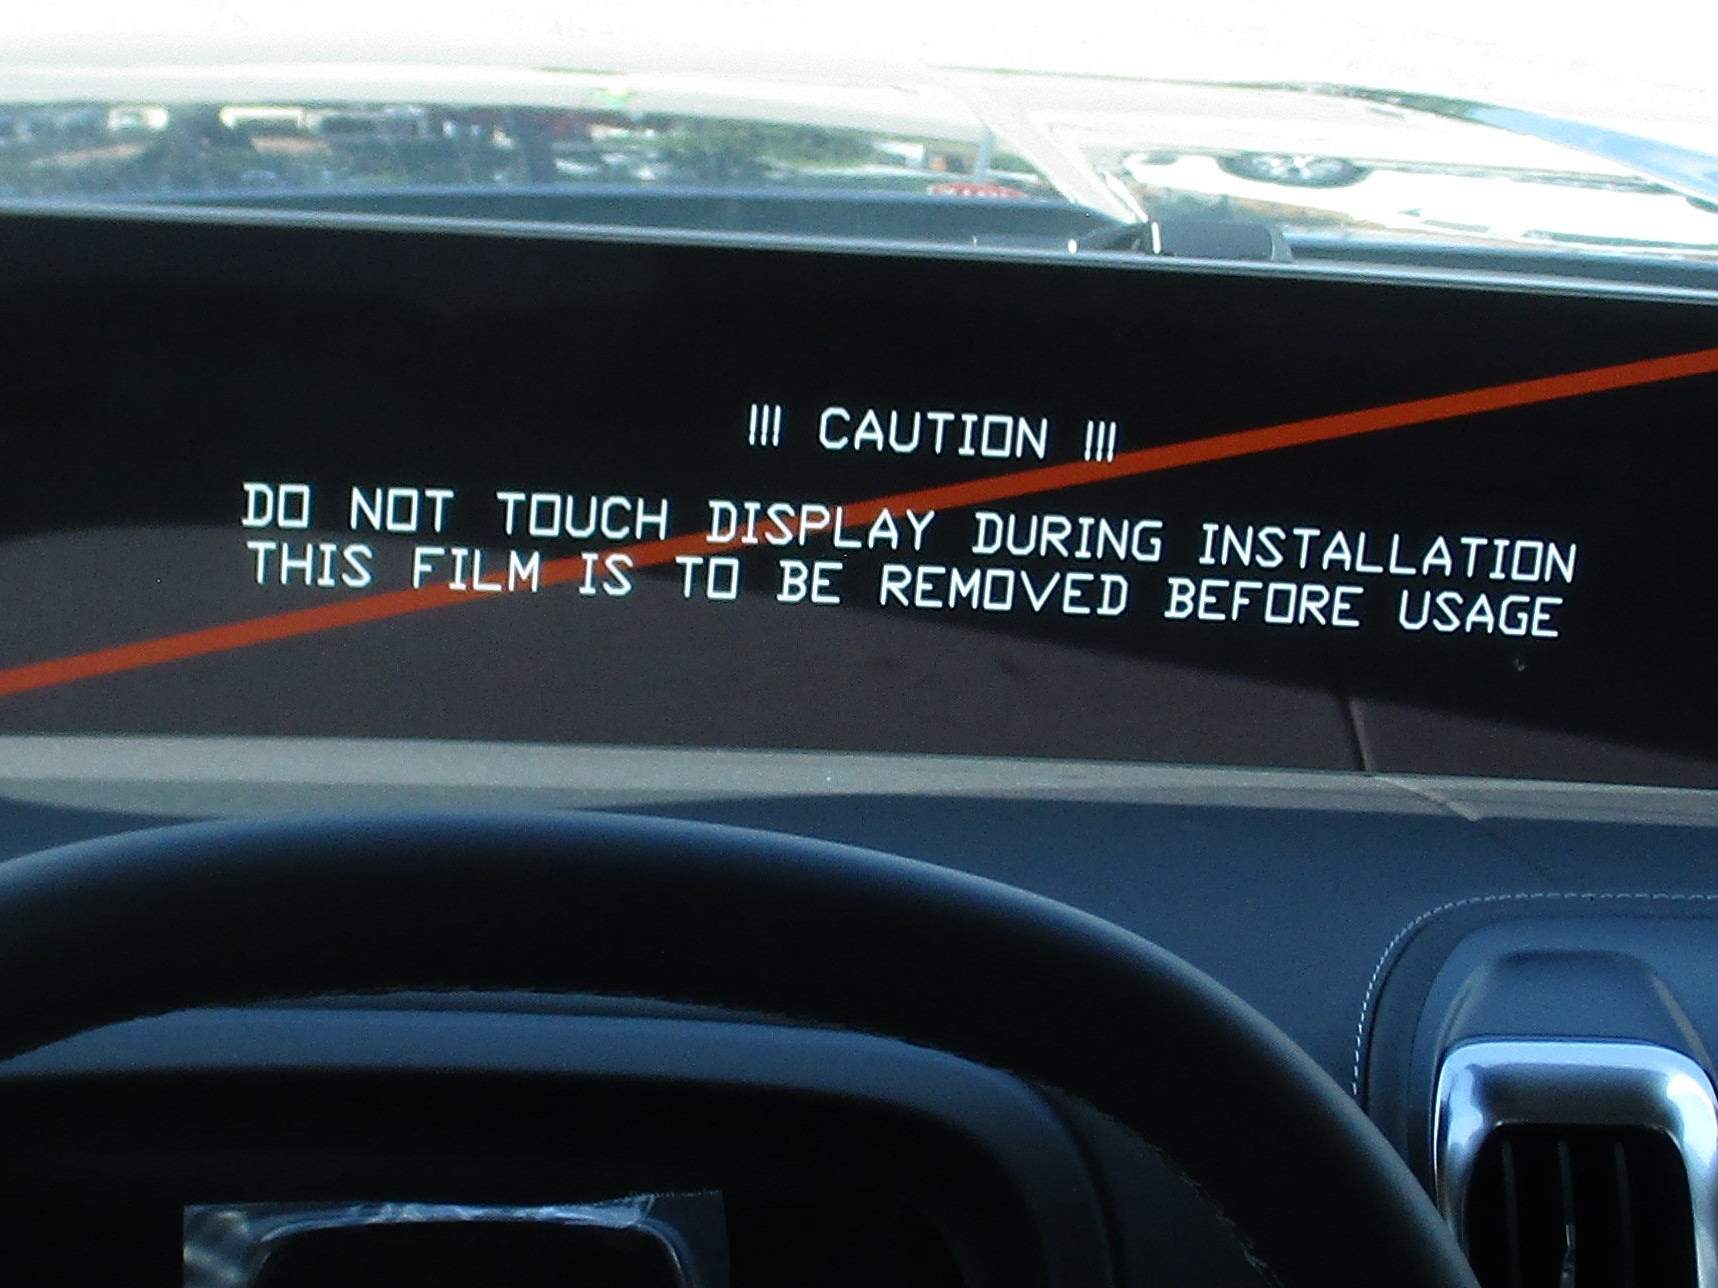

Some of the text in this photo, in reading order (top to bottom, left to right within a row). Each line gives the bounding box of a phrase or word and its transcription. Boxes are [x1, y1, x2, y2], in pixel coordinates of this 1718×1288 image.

[819, 406, 1049, 460] CAUTION
[241, 482, 1578, 583] DO NOT TOUCH DISPLAY DURING INSTALLATION
[246, 540, 1565, 639] THIS FILM IS TO BE REMOVED BEFORE USAGE
